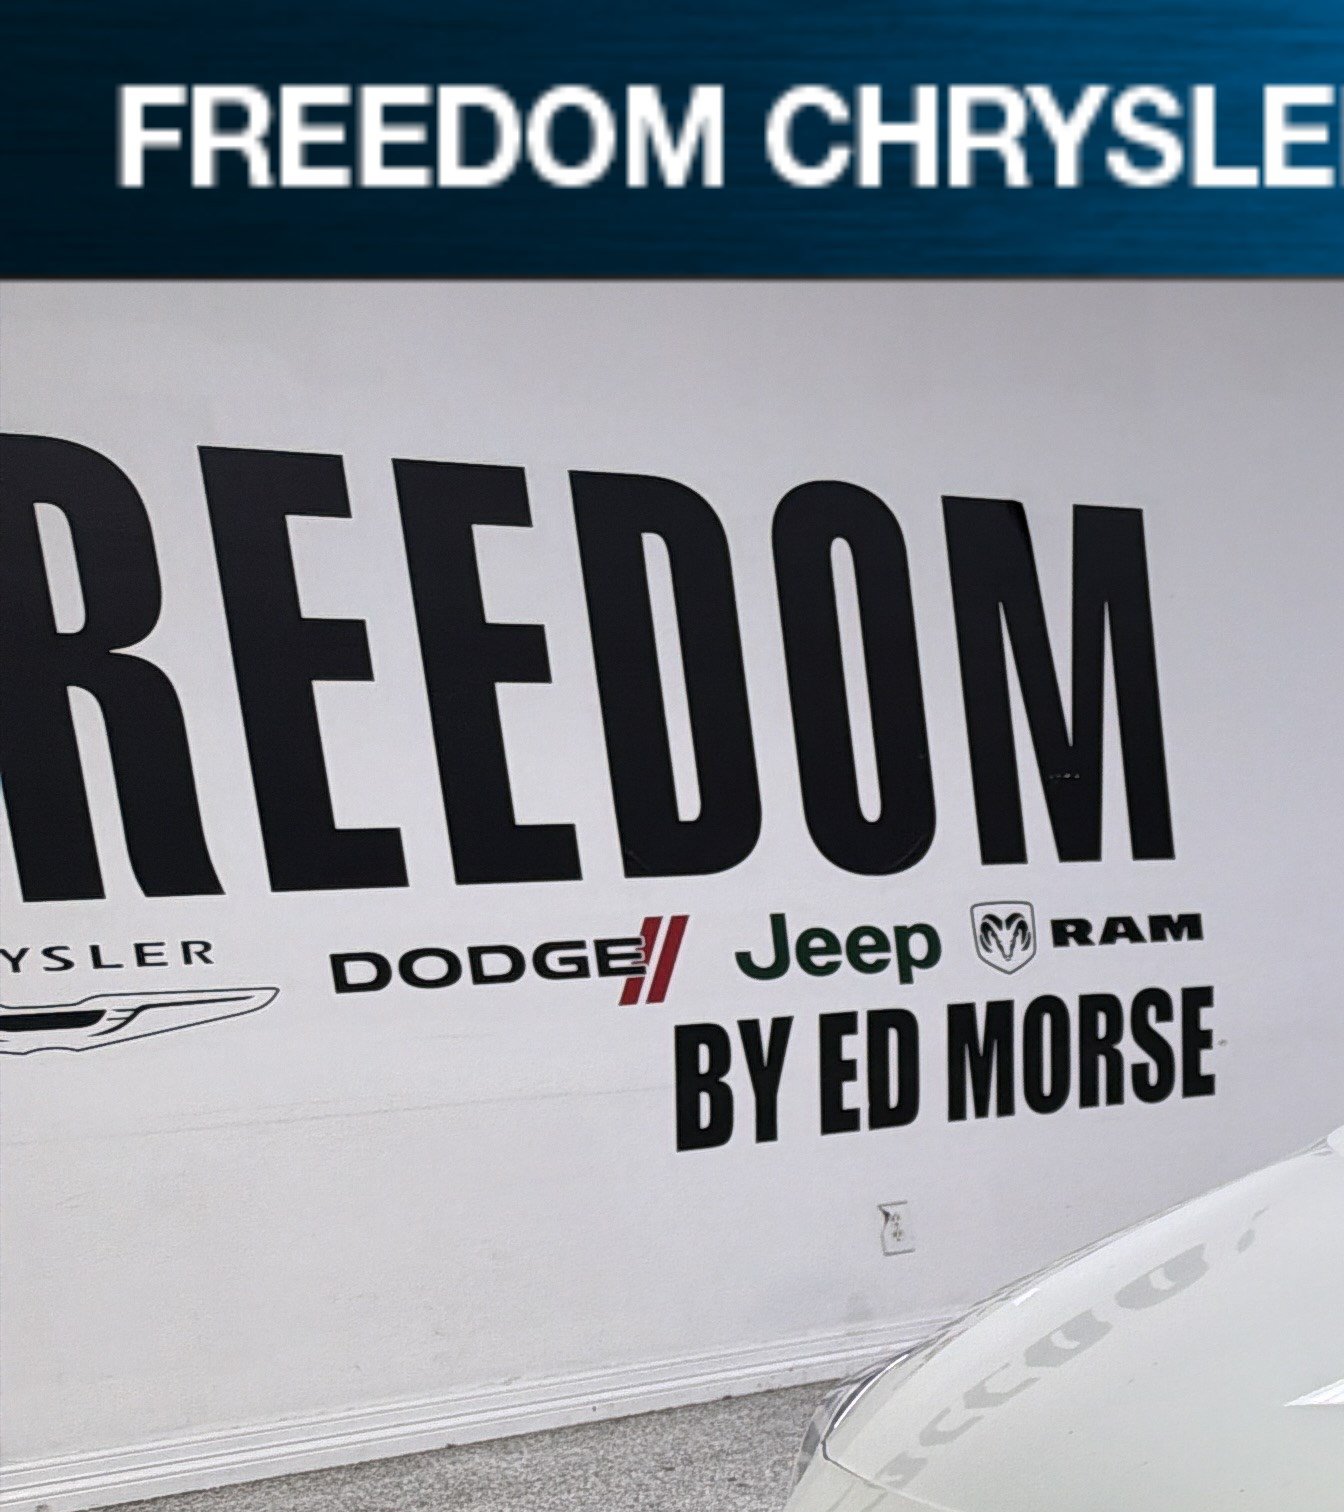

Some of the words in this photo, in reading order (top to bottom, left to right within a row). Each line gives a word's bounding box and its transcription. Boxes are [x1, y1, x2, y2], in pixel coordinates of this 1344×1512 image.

[0, 431, 1177, 904] REEDOM
[0, 939, 215, 974] YSLER
[328, 936, 649, 995] DODGE
[733, 911, 944, 986] Jeep
[1050, 912, 1205, 949] RAM
[674, 1014, 795, 1153] BY
[818, 1007, 922, 1137] ED
[945, 984, 1217, 1124] MORSE
